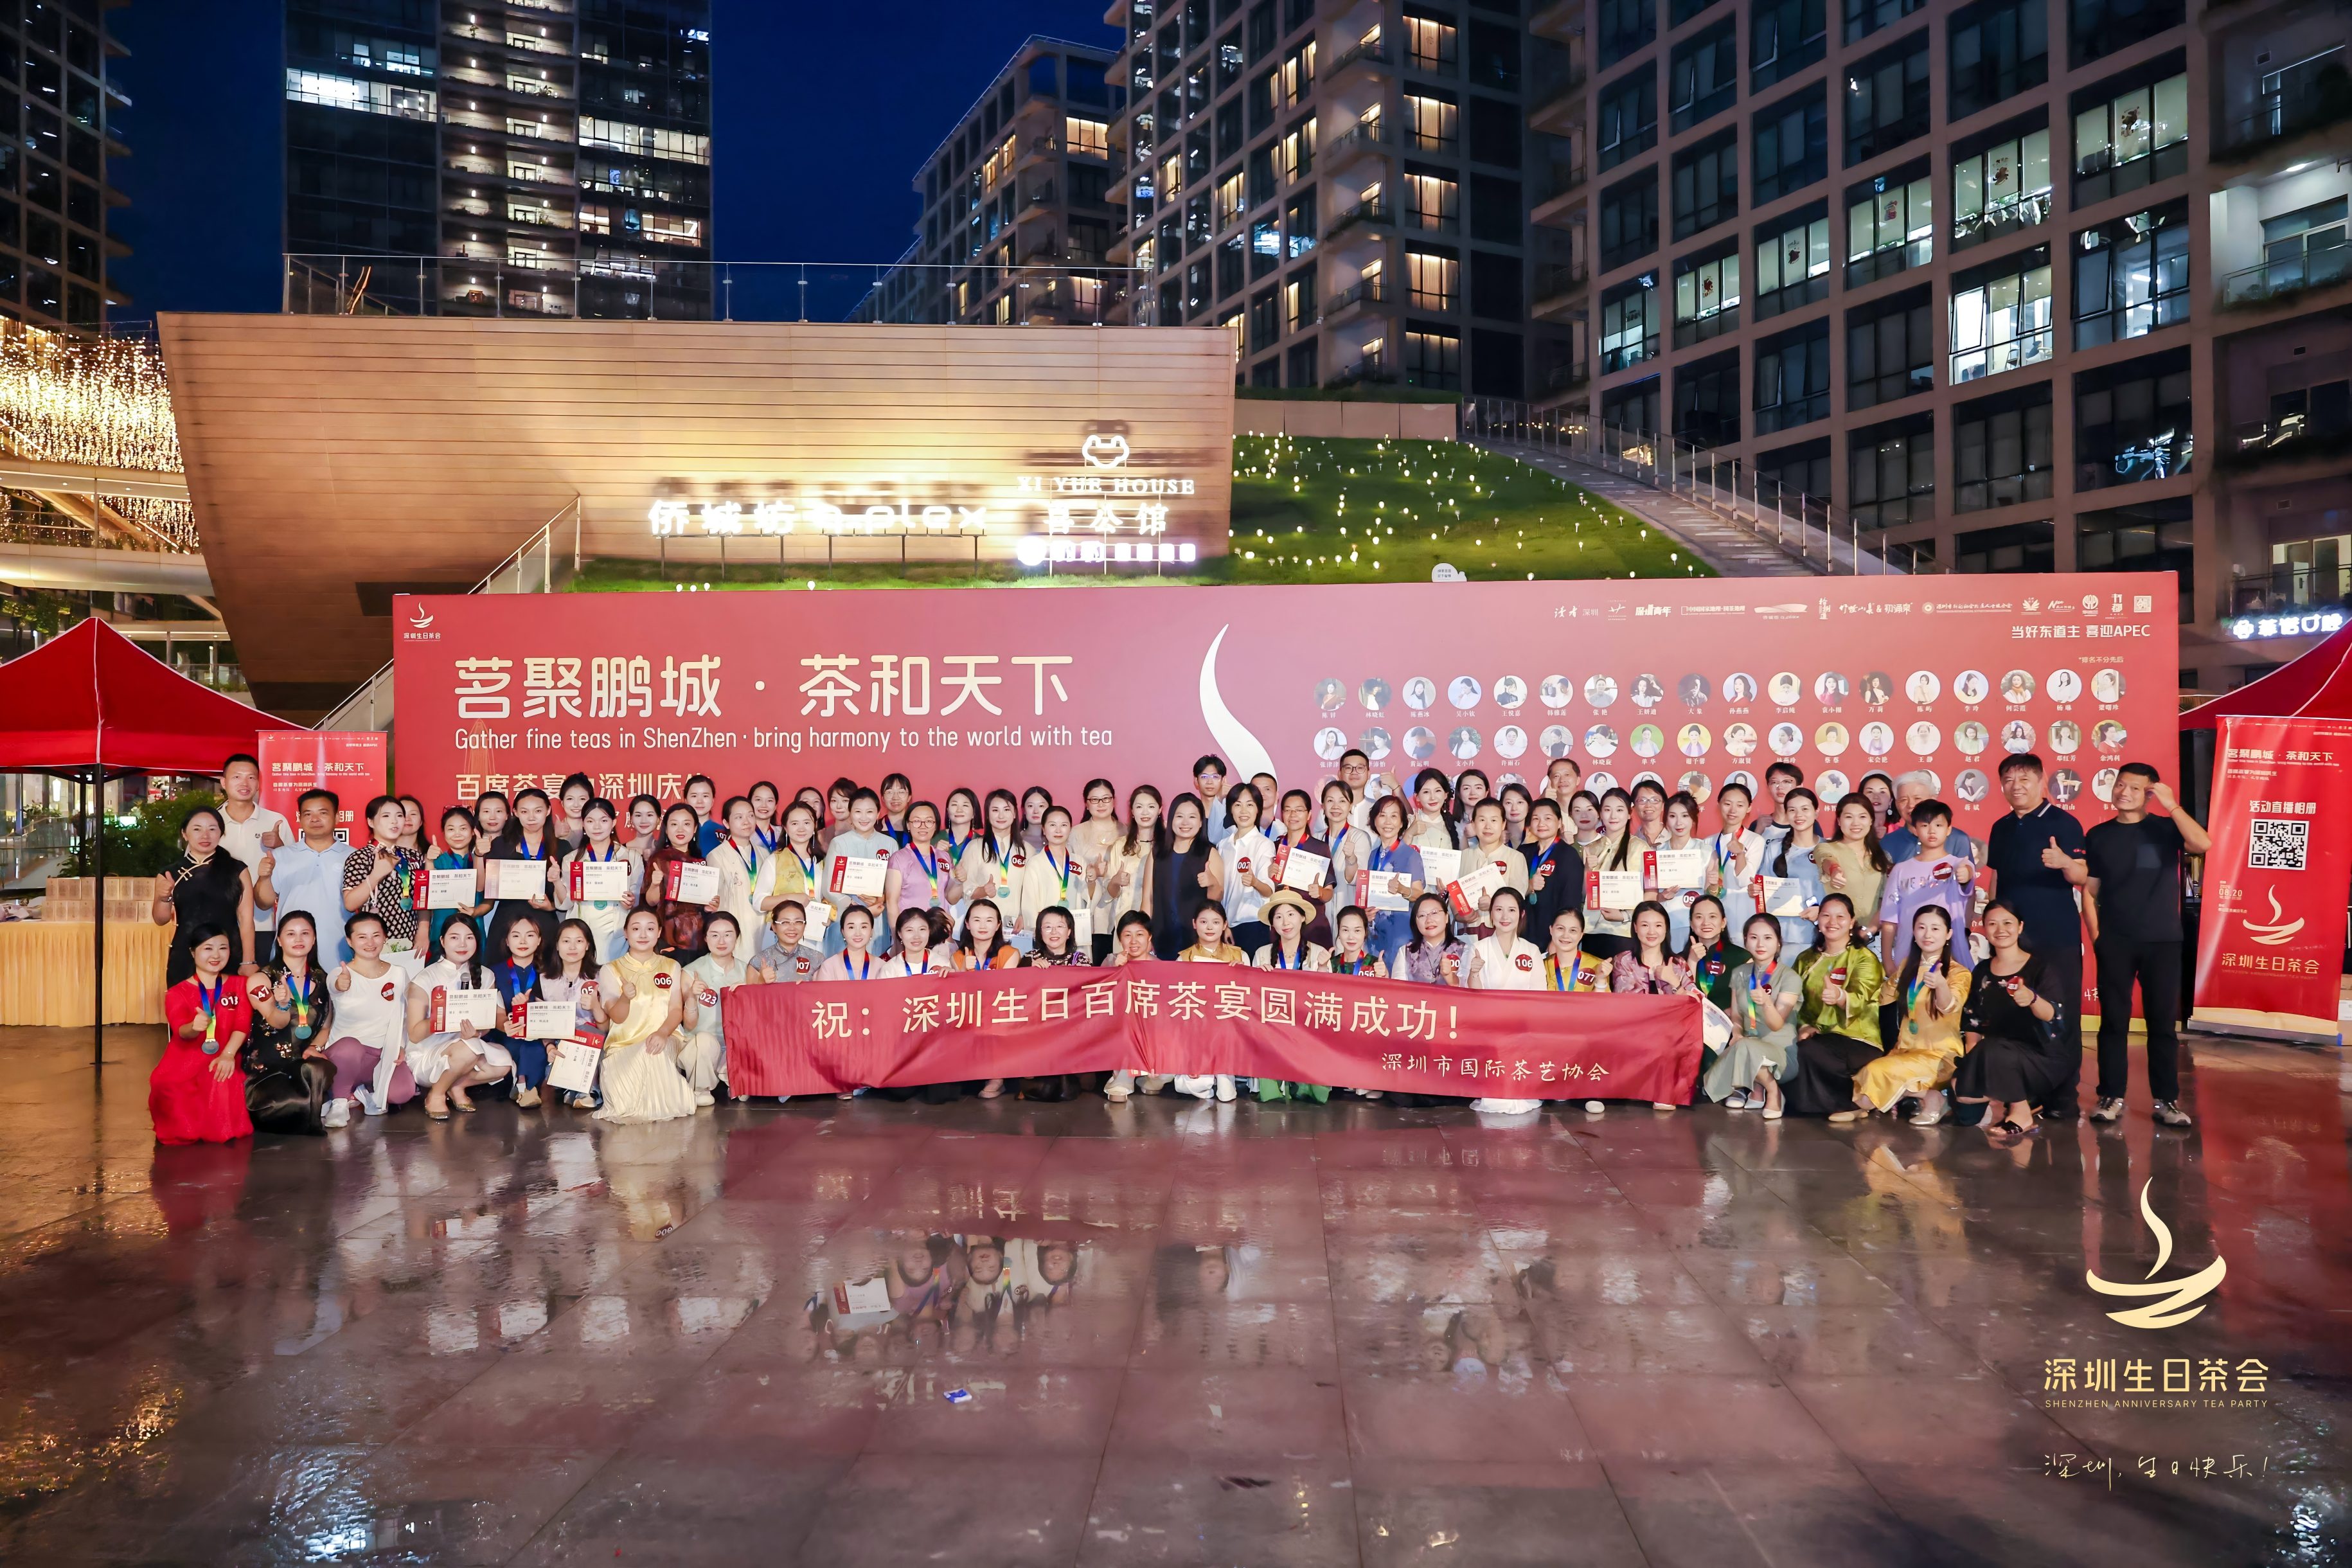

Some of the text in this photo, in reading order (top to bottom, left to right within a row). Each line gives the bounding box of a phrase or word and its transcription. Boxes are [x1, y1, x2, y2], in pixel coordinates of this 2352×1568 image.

[1053, 477, 1101, 492] YUE
[1114, 479, 1195, 495] HOUSE
[648, 499, 795, 535] 侨城坊
[2011, 625, 2151, 638] 当好东道主 喜迎APEC
[454, 727, 518, 751] Gather
[526, 726, 562, 749] fine
[571, 728, 611, 749] teas
[619, 727, 636, 749] in
[643, 726, 736, 749] ShenZhen
[753, 727, 801, 753] bring
[809, 726, 891, 753] harmony
[900, 728, 918, 747] to
[927, 726, 958, 747] the
[967, 726, 1022, 747] world
[1030, 726, 1072, 746] with
[1081, 727, 1112, 746] tea
[456, 773, 711, 800] 百席茶宴深圳庆
[2249, 800, 2317, 815] 活动直播相册
[1540, 864, 1555, 873] 091
[2218, 889, 2243, 897] 08.20
[1683, 895, 1695, 904] 09
[796, 959, 810, 970] 07
[1516, 959, 1533, 968] 106
[2222, 953, 2320, 974] 深圳生日茶会
[654, 976, 672, 985] 006
[1578, 971, 1596, 983] 077
[699, 992, 717, 1004] 023
[1381, 1052, 1610, 1083] 深圳市国际茶艺协会
